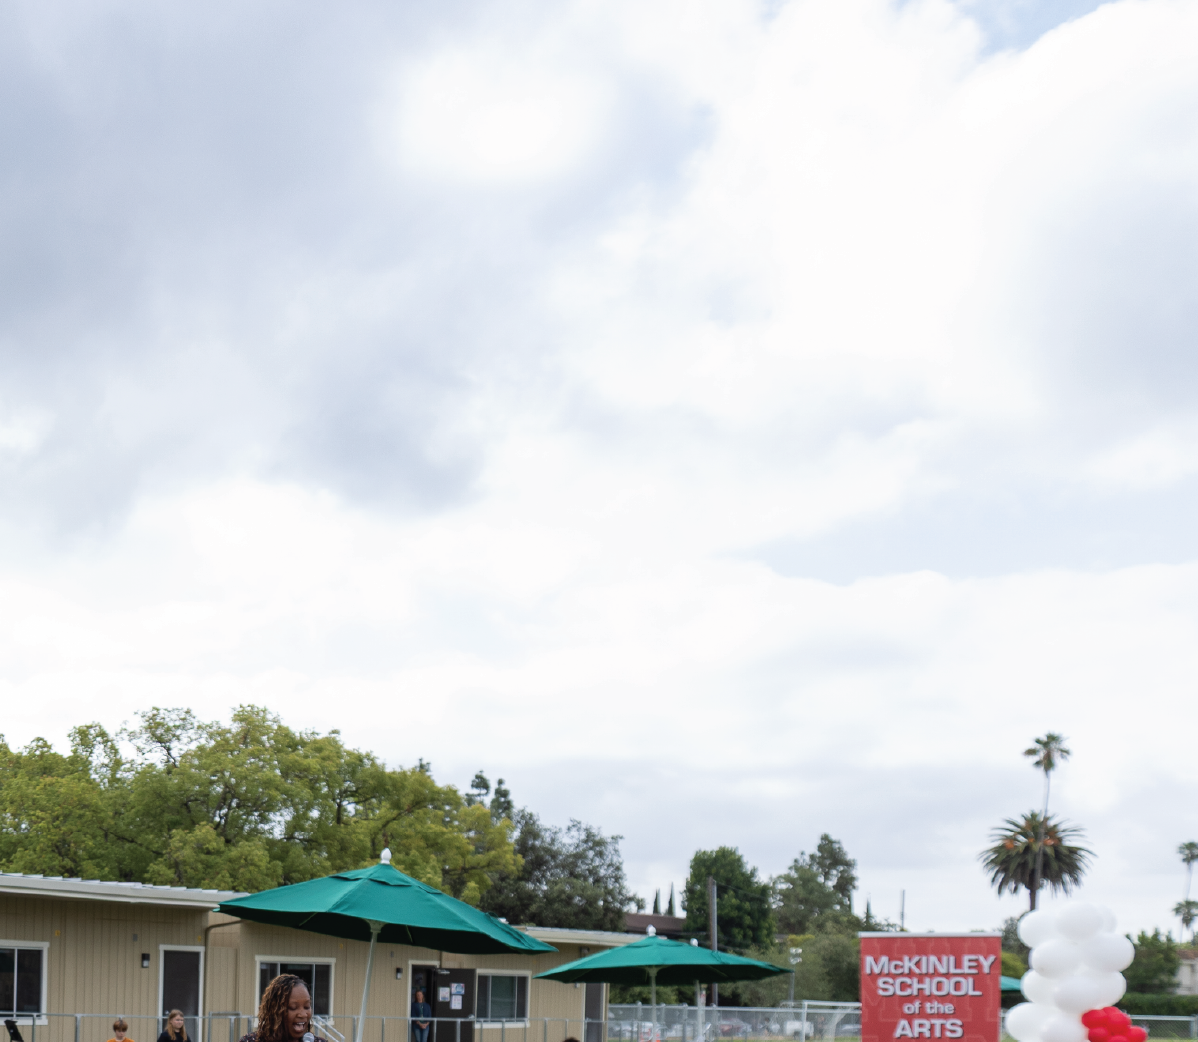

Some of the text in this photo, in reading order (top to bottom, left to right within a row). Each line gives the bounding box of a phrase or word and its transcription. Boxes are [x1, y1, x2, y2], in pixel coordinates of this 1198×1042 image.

[865, 954, 997, 975] McKINLEY
[877, 976, 983, 996] SCHOOL
[903, 1000, 955, 1014] of the
[894, 1018, 963, 1038] ARTS
